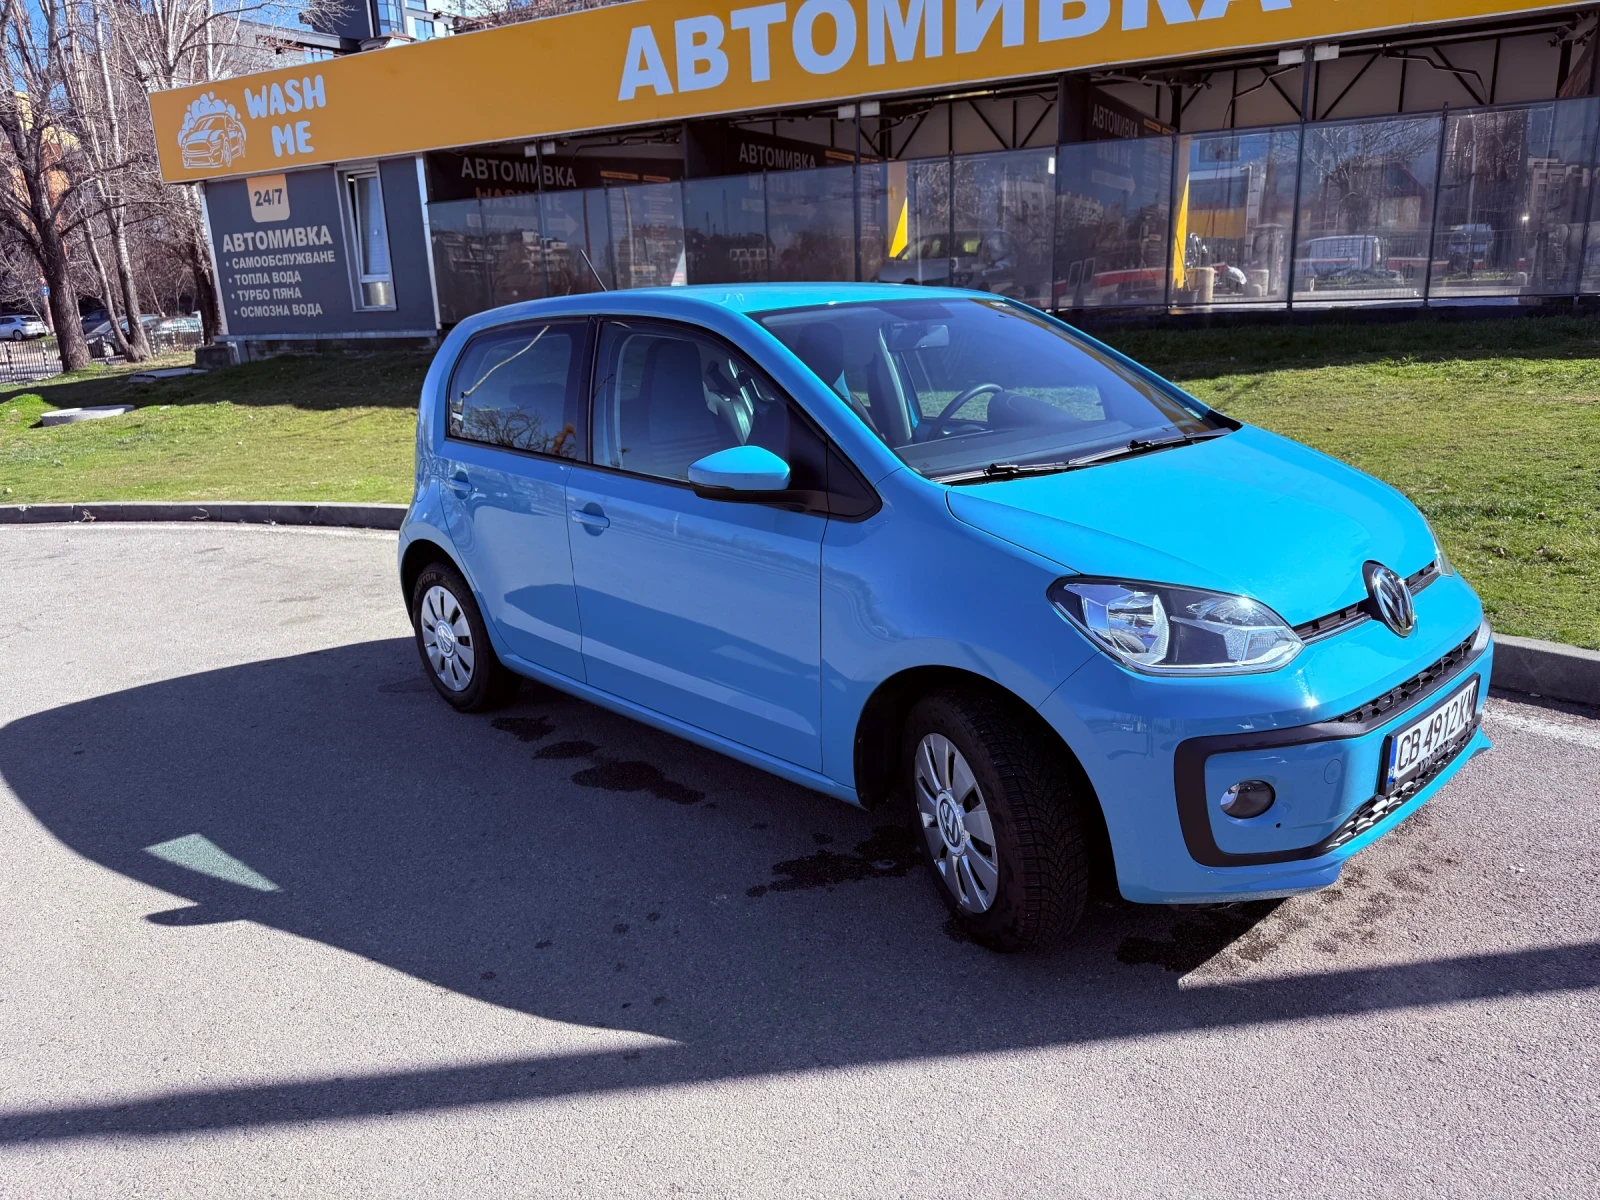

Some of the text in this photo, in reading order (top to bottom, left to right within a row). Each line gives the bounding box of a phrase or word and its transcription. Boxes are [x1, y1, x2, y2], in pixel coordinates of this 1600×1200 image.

[618, 0, 1292, 101] АВТОМИ
[244, 74, 326, 119] WASH
[271, 121, 315, 157] ME
[739, 142, 816, 170] АВТОМИВКА
[461, 156, 577, 187] АВТОМИВКА
[253, 188, 283, 207] 24/7
[222, 225, 333, 253] АВТОМИВКА
[232, 250, 336, 270] САМООБСЛУЖВАНЕ
[234, 270, 302, 286] ТОПЛА ВОДА
[237, 287, 303, 302] ТУРБО ПЯНА
[240, 302, 324, 319] ОСМОЗНА ВОДА
